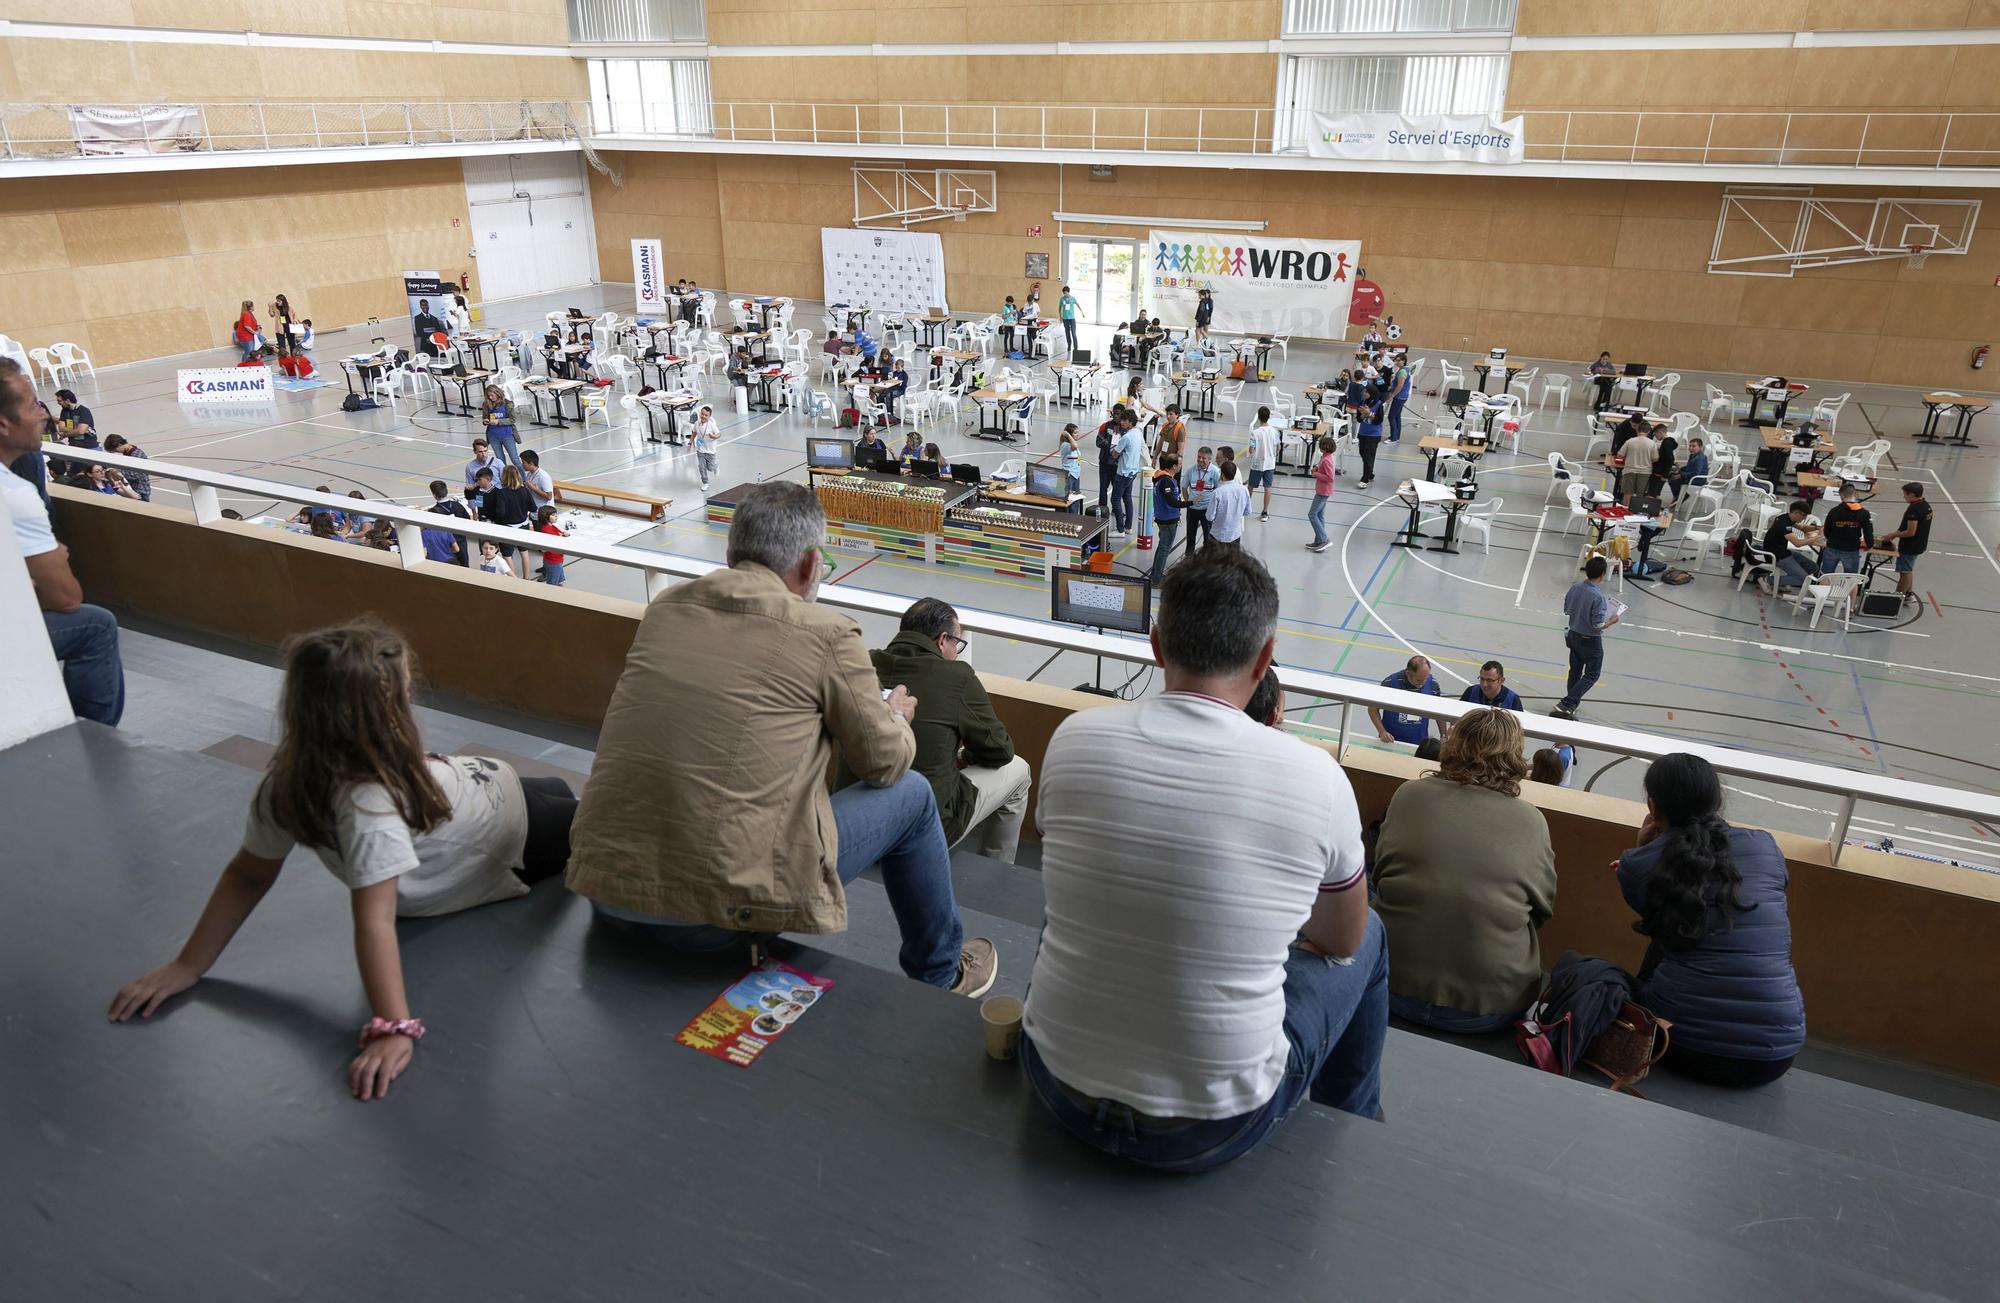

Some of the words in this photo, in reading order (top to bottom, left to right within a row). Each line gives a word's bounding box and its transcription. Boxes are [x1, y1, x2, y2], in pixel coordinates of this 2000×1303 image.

[1388, 130, 1435, 145] Servei
[1438, 131, 1511, 149] d'Esports
[1248, 247, 1332, 282] WRO
